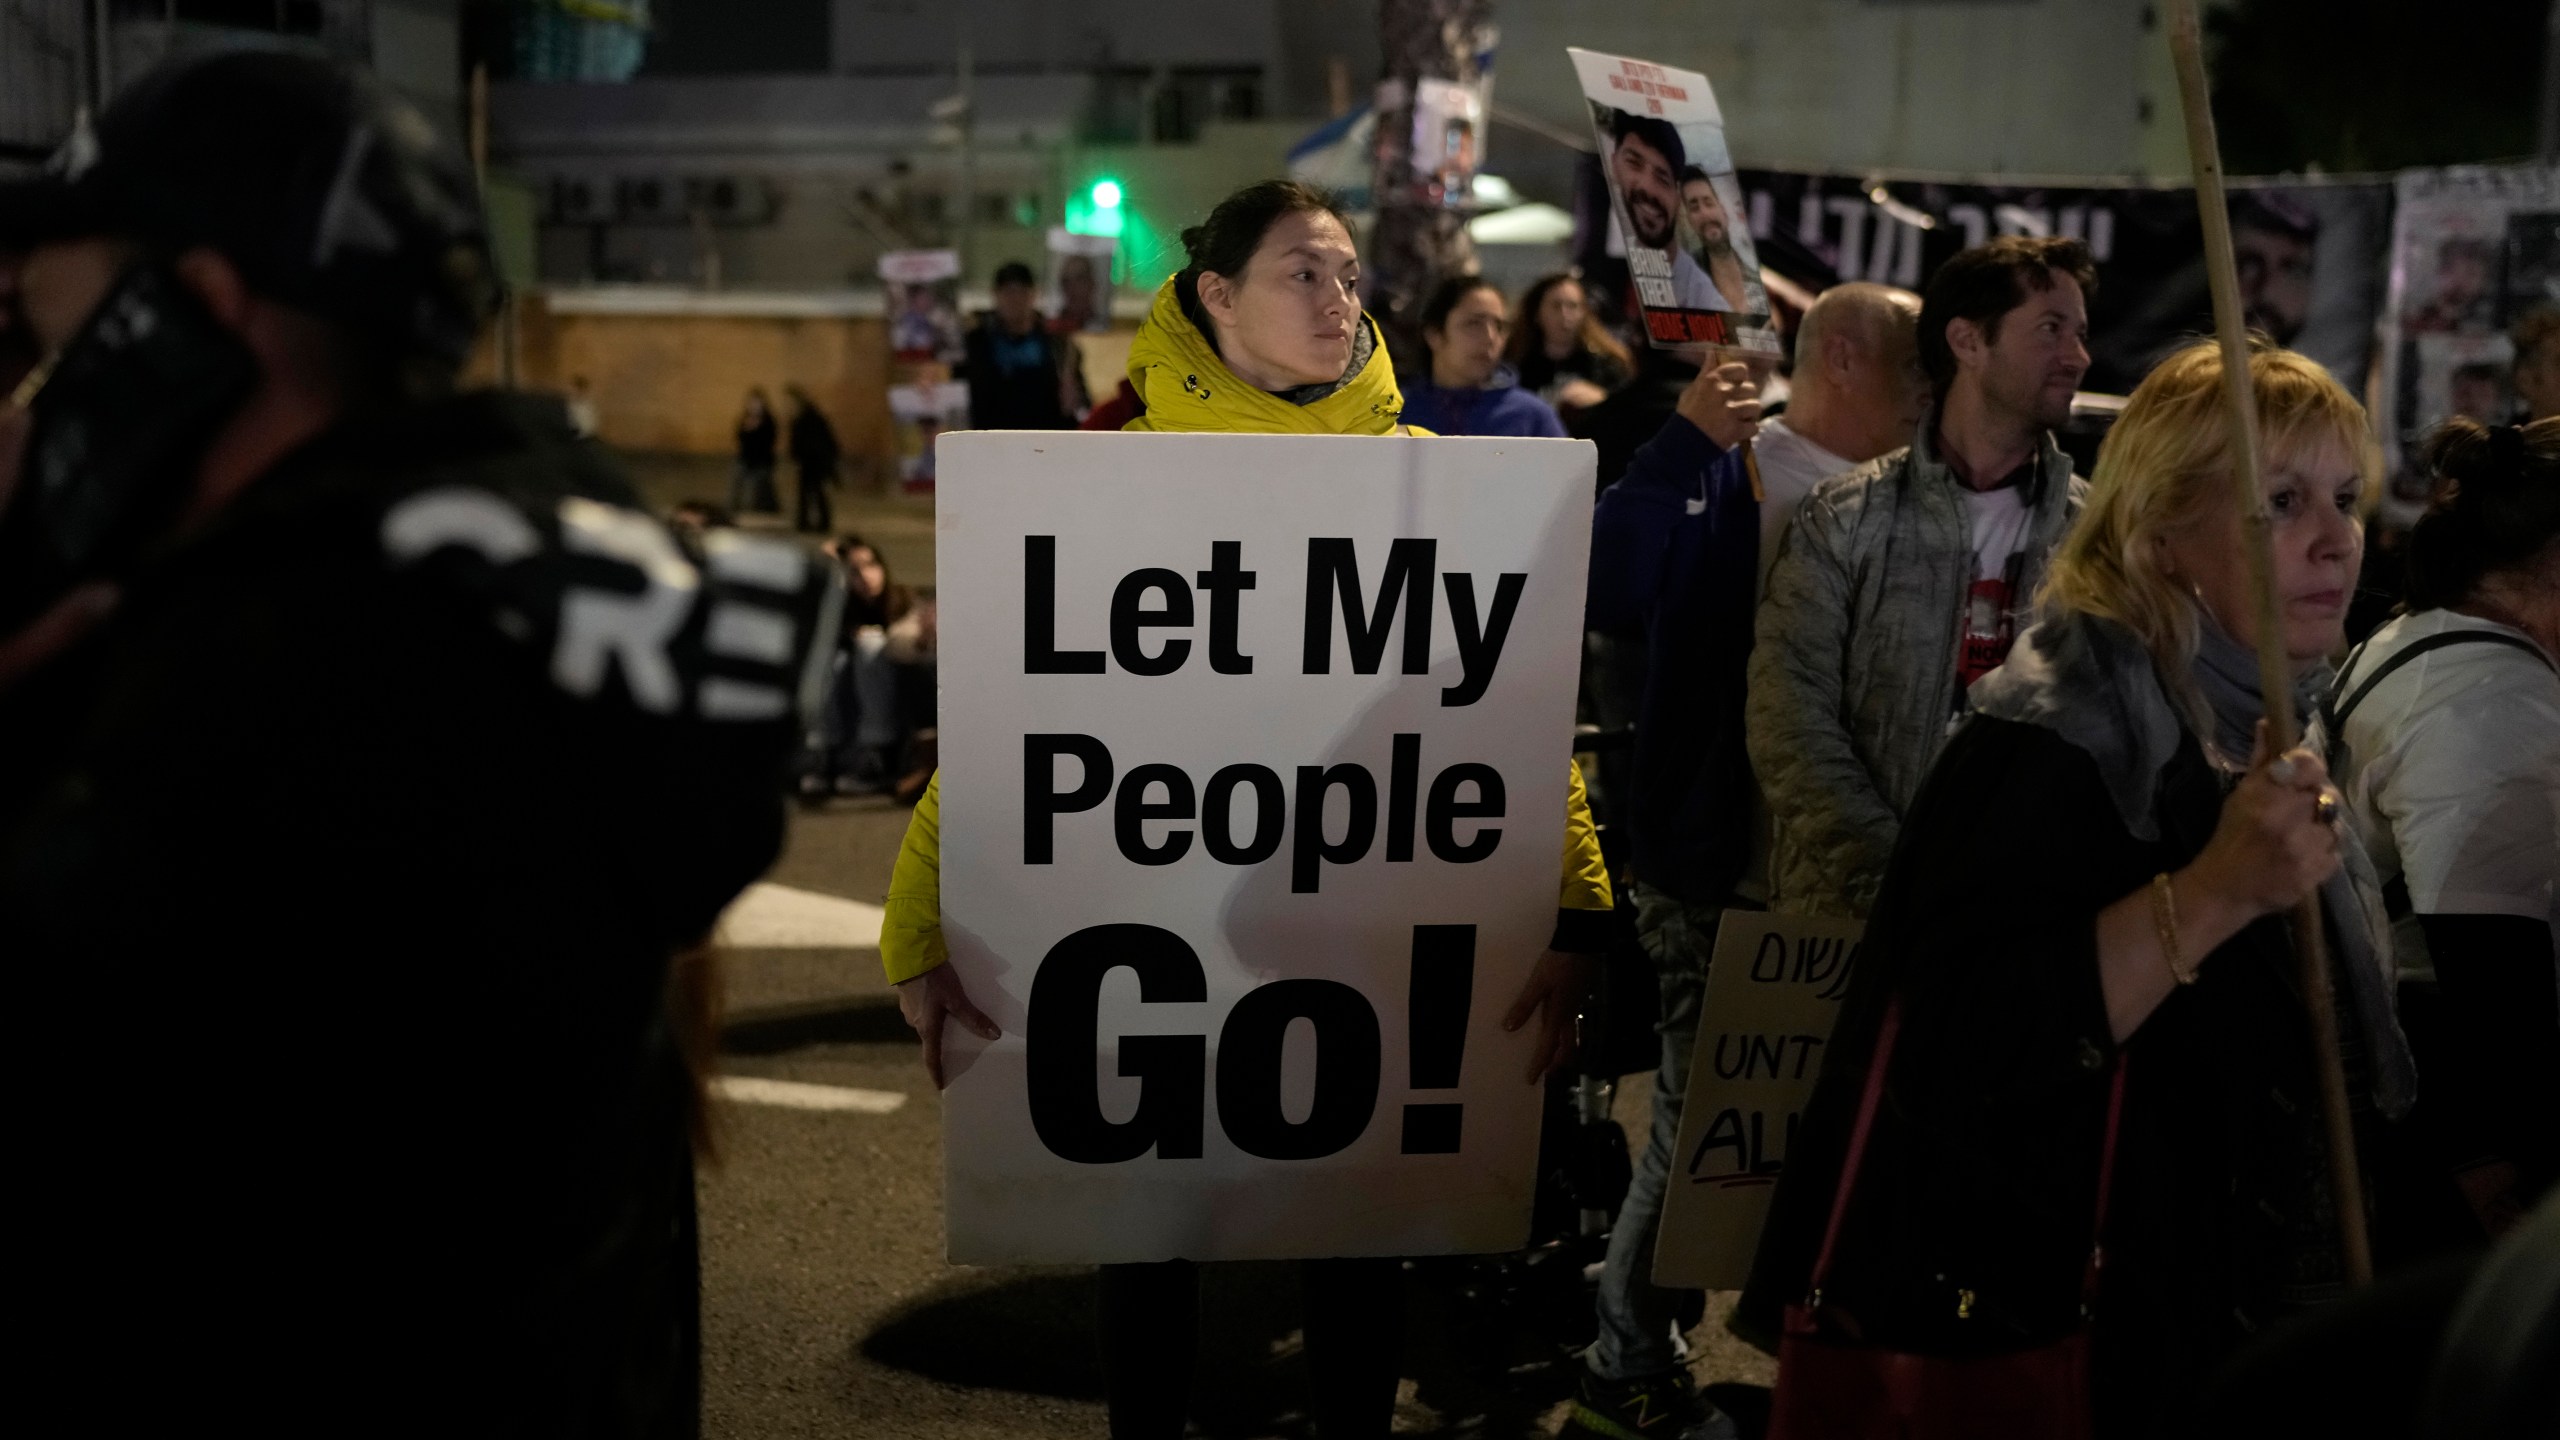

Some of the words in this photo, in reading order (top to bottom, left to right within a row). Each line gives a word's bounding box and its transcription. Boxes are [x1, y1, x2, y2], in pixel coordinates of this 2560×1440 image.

[1629, 247, 1672, 277] BRING
[1636, 276, 1678, 307] THEM
[1646, 311, 1690, 341] HOME
[1024, 536, 1257, 676] Let
[1303, 537, 1528, 708] My
[1023, 733, 1507, 894] People
[1026, 923, 1478, 1165] Go!
[1714, 1034, 1823, 1080] UNT
